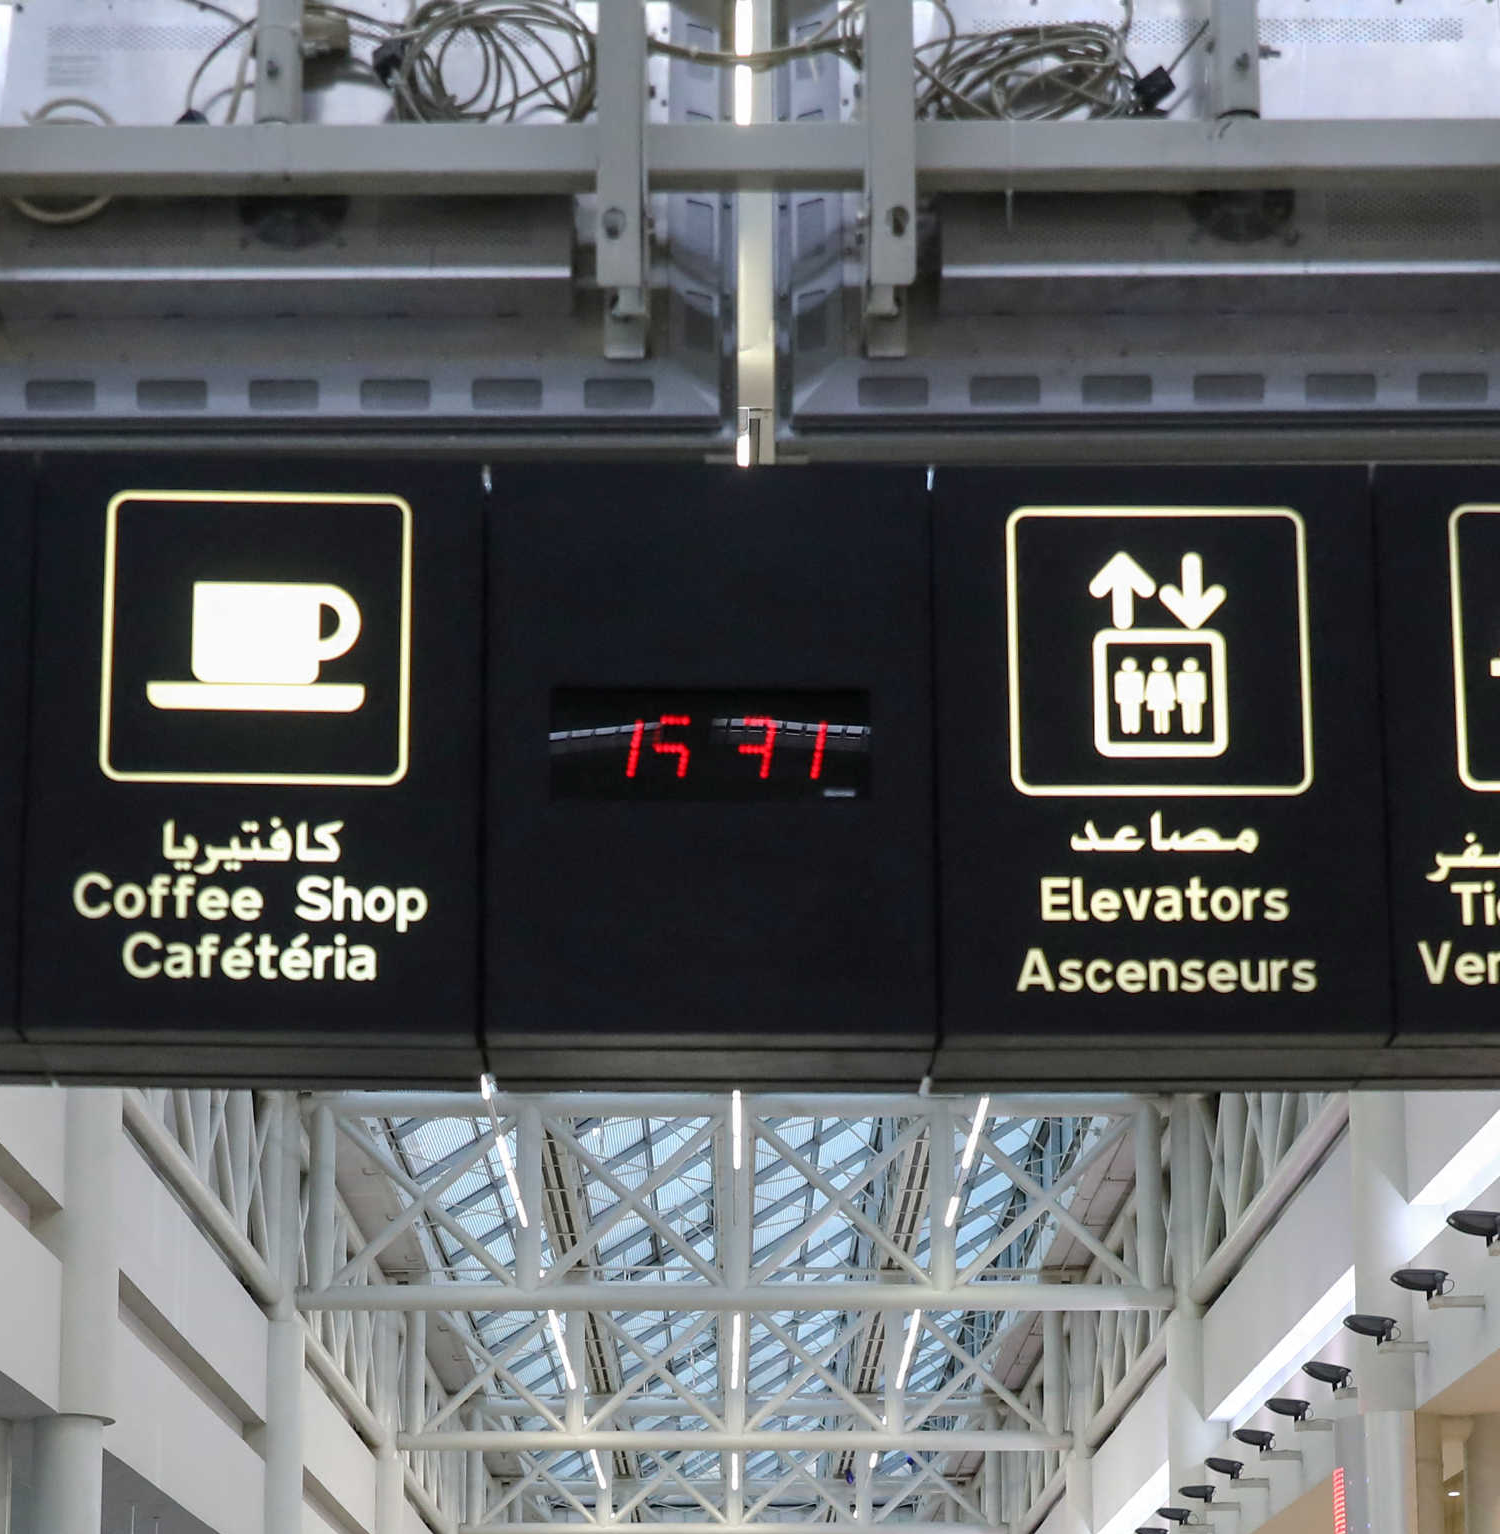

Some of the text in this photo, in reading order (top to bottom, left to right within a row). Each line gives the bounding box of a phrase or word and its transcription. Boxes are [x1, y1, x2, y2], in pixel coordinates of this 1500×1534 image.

[162, 816, 344, 875] كافتيريا
[1070, 812, 1260, 856] مصاعد
[72, 872, 429, 933] Coffee Shop
[1039, 876, 1290, 923] Elevators
[121, 931, 378, 982] Cafétéria
[1016, 947, 1318, 994] Ascenseurs
